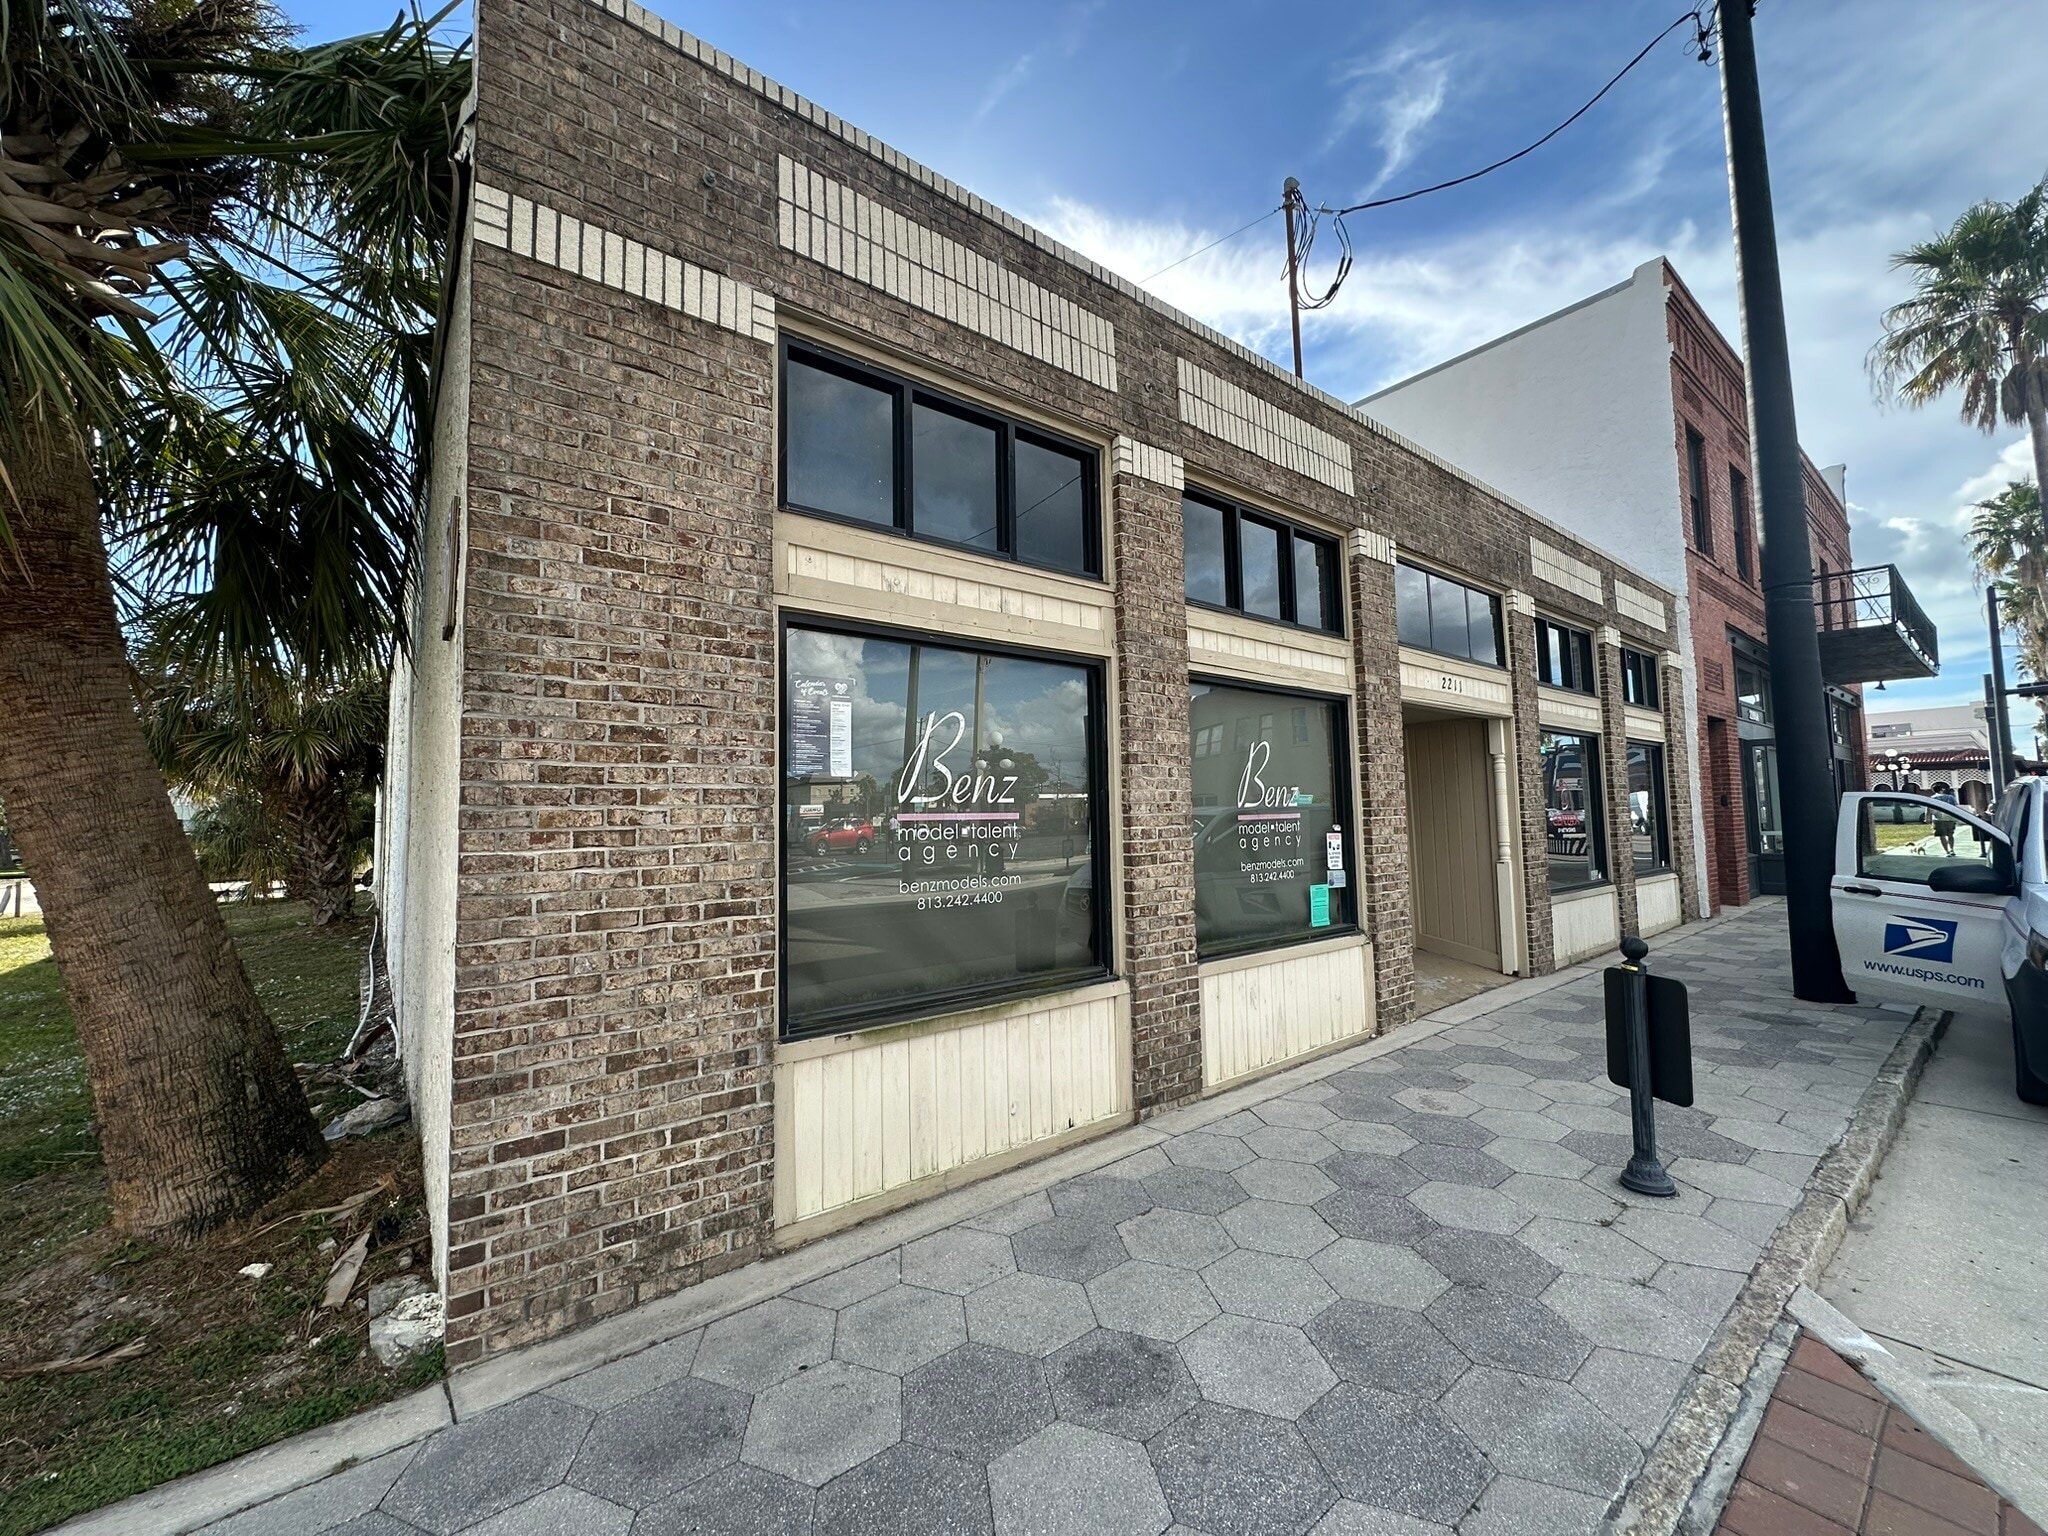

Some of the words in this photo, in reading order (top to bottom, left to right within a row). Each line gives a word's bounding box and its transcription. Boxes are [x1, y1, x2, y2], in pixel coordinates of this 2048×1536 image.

[1442, 677, 1462, 693] 2211
[898, 711, 1018, 803] Benz
[1238, 741, 1299, 808] Benz
[1239, 835, 1301, 851] agency
[898, 843, 1018, 864] agency
[1240, 858, 1304, 872] benzmodels.com
[899, 875, 1021, 894] benzmodels.com
[1250, 870, 1295, 883] 813.242.4400
[917, 891, 1003, 910] 813.242.4400
[1864, 961, 1985, 989] www.usps.com
